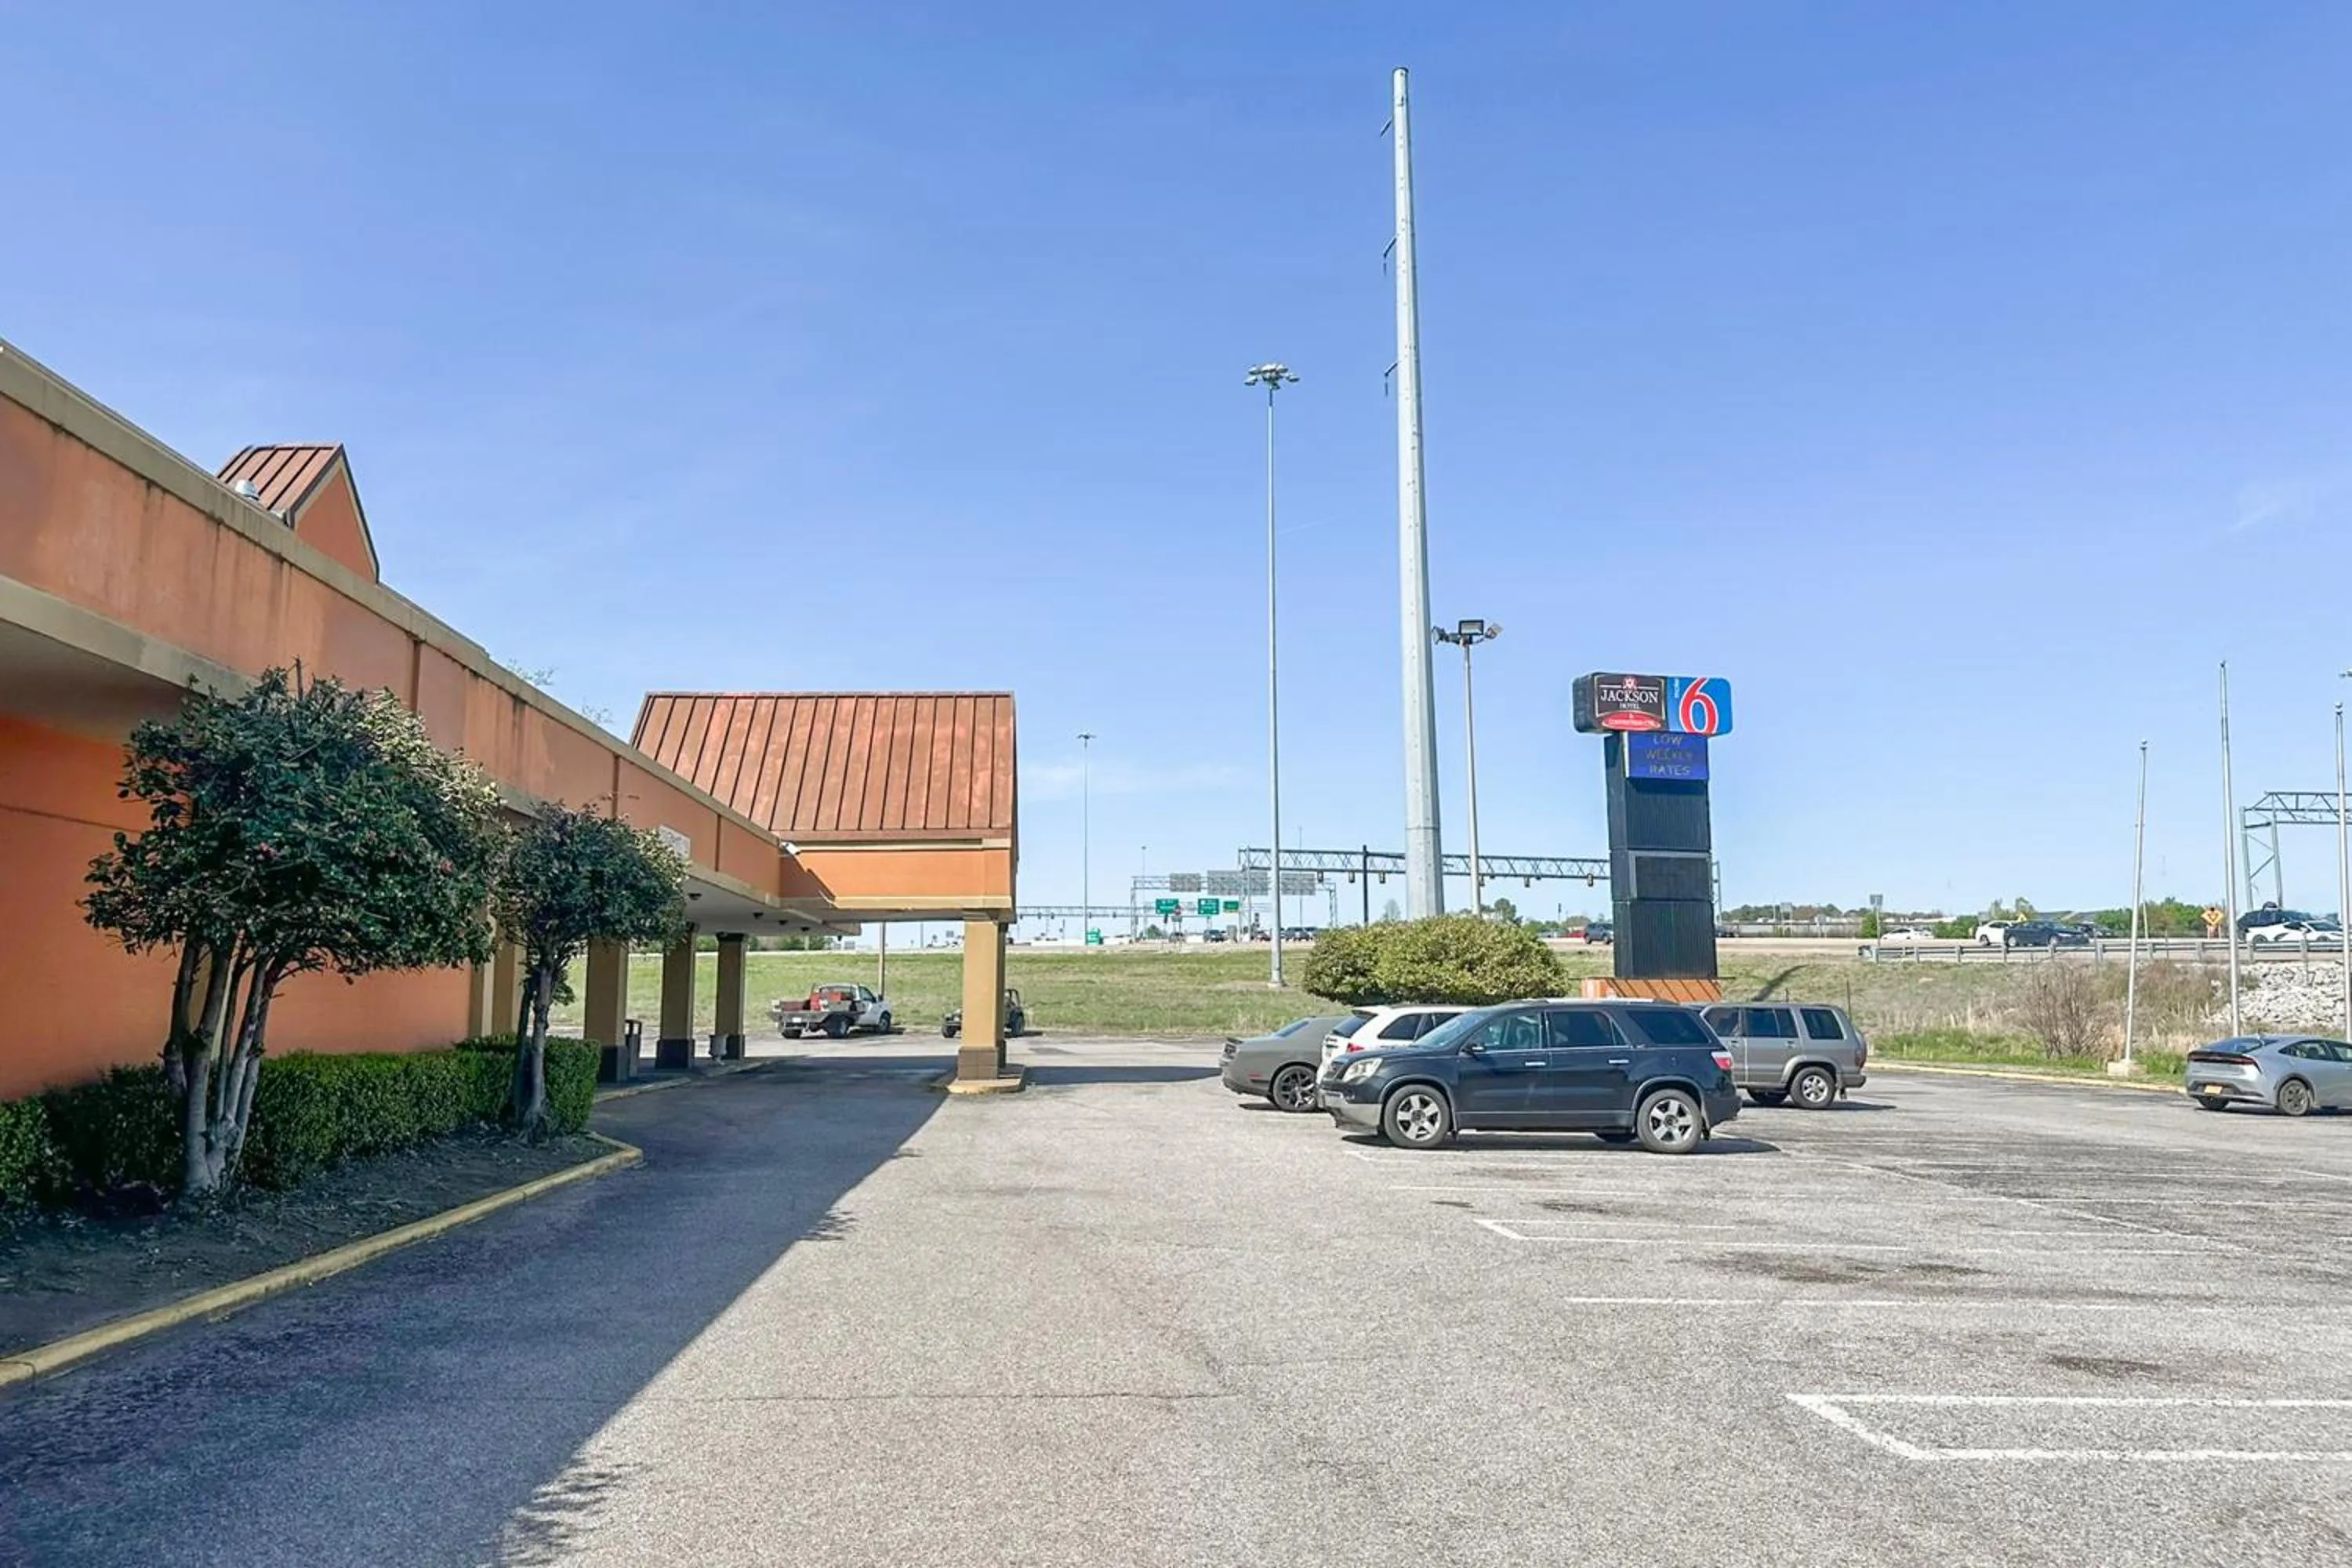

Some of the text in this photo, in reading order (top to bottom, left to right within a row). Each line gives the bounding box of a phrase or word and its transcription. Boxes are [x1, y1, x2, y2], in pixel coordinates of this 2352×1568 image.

[1600, 690, 1658, 702] JACKSON
[1679, 677, 1719, 735] 6
[1653, 734, 1683, 746] LOW
[1650, 764, 1691, 775] RATES
